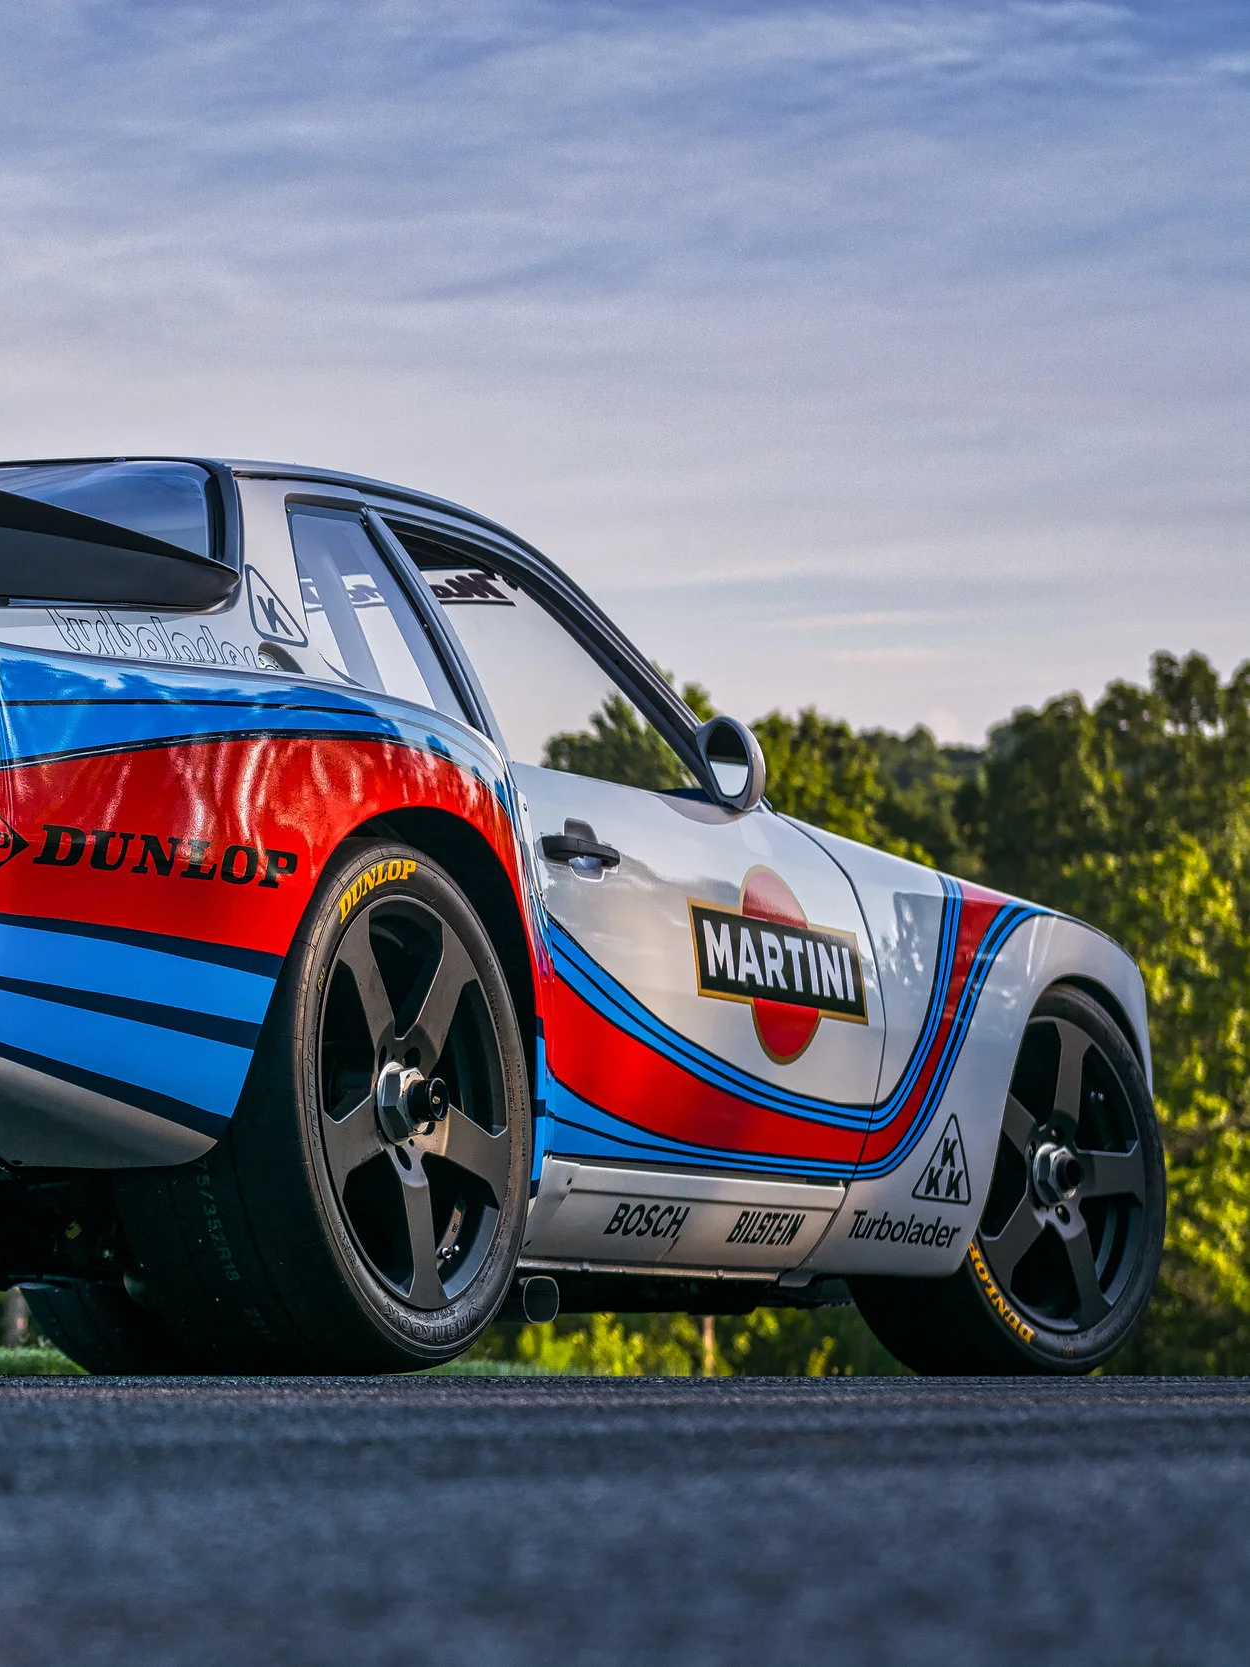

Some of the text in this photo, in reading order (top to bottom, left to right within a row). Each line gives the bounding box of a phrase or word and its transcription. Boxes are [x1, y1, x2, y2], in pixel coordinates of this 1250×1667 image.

[32, 823, 298, 889] DUNLOP
[338, 859, 417, 924] DUNLOP
[702, 919, 856, 1002] MARTINI
[603, 1203, 691, 1239] BOSCH
[725, 1210, 807, 1246] BILSTEIN
[848, 1209, 962, 1249] Turbolader
